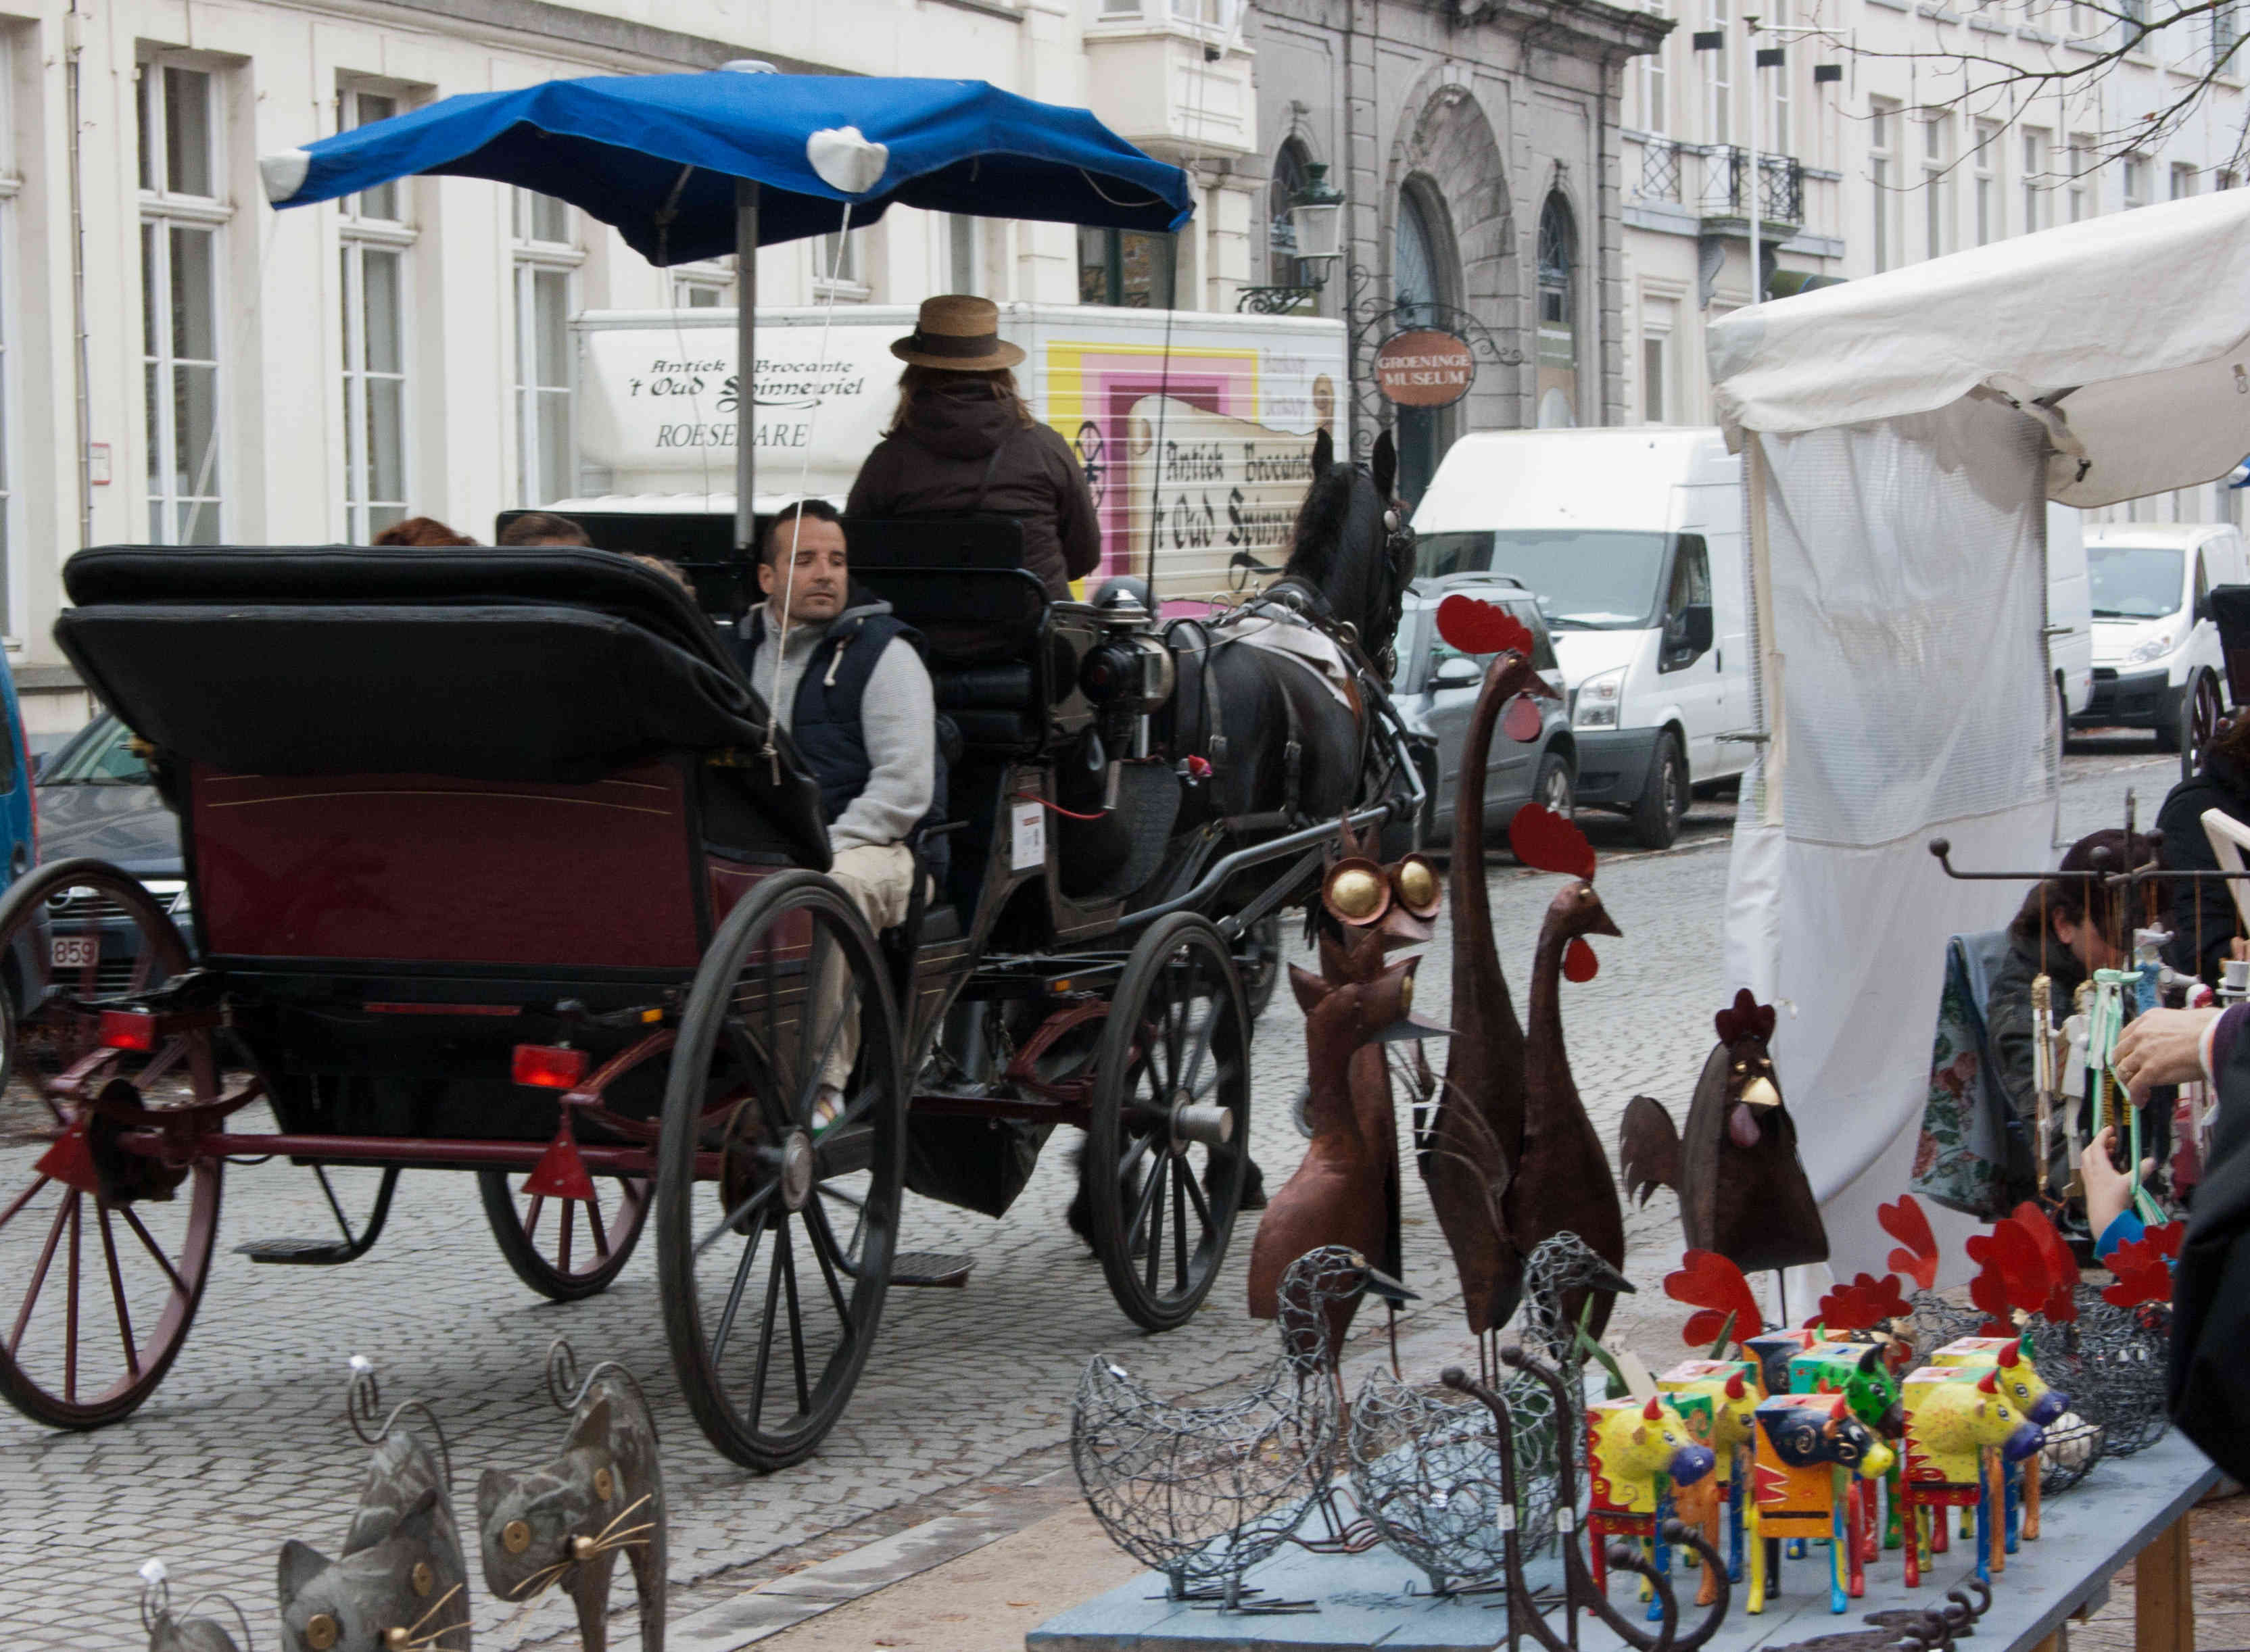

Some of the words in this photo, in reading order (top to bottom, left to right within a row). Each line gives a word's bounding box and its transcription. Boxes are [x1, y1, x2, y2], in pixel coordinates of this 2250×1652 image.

[650, 359, 726, 373] Antiek
[754, 359, 854, 373] Brocante
[1379, 354, 1470, 368] GROENINGE
[650, 376, 704, 396] Oud
[1385, 370, 1465, 385] MUSEUM
[655, 423, 809, 447] ROESEARE
[1166, 440, 1224, 481] Antiek
[55, 942, 96, 964] 859
